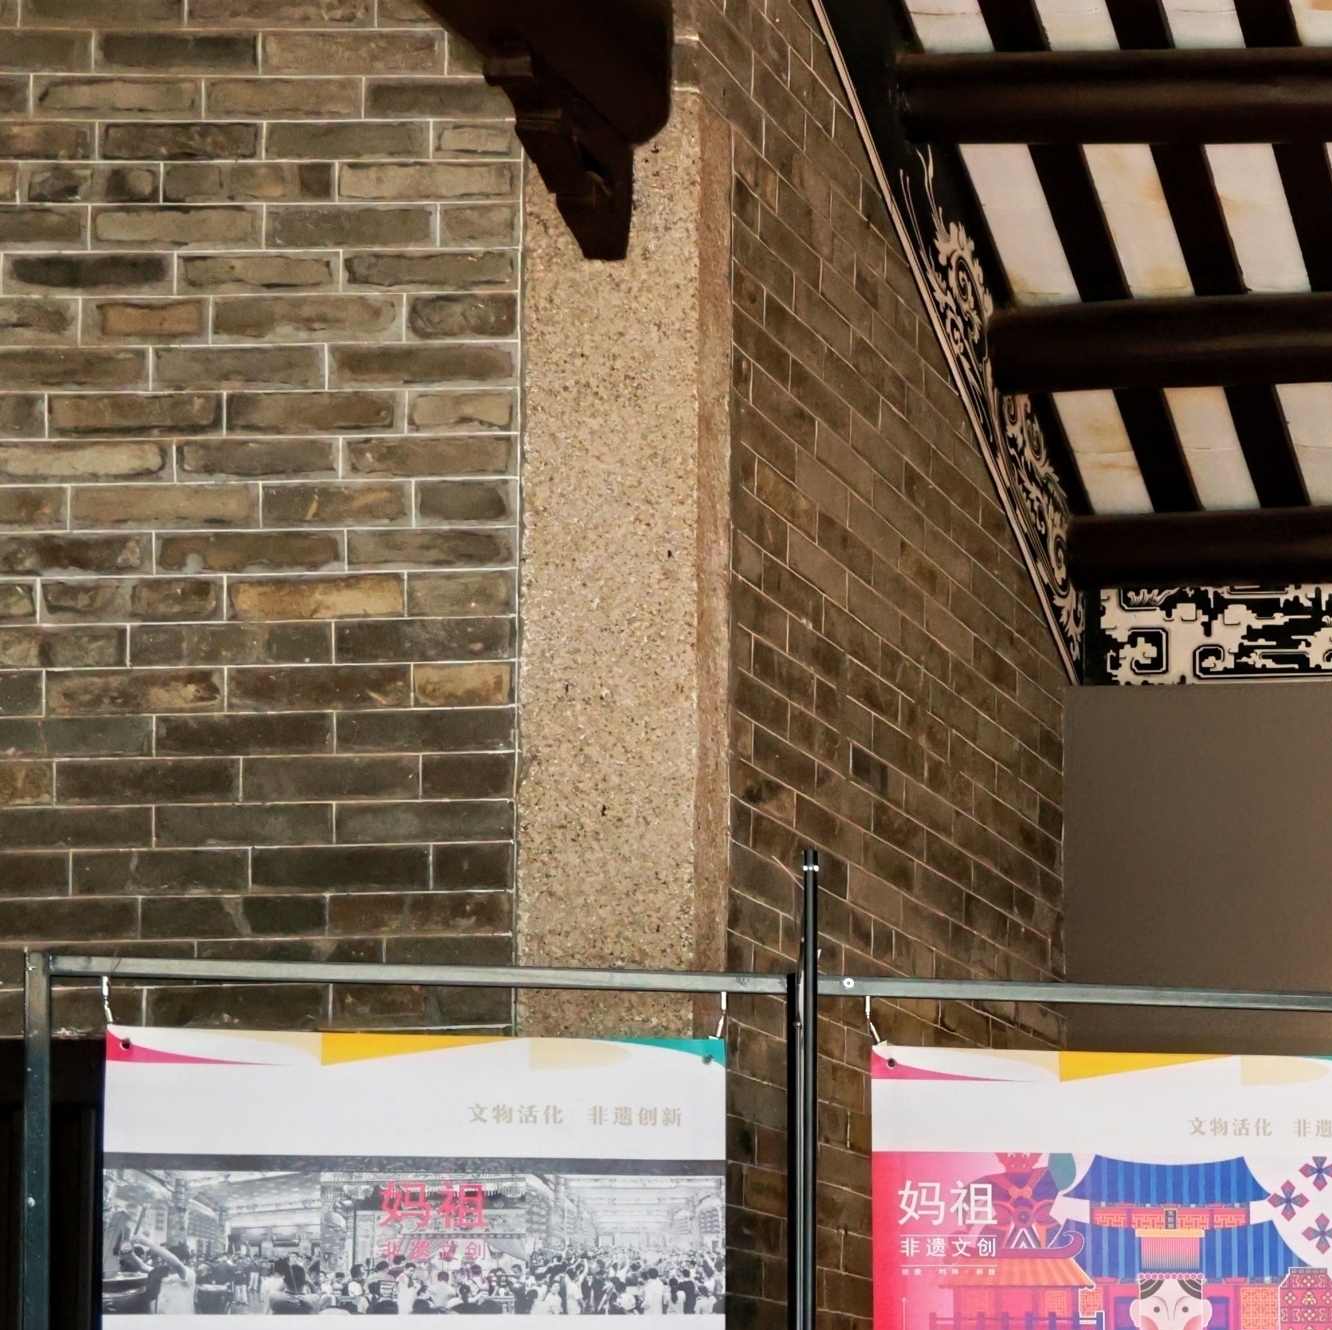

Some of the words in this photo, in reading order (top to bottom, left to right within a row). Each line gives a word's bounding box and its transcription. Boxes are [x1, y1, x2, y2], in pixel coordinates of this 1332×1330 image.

[468, 1103, 564, 1126] 文物活化
[587, 1104, 684, 1128] 非遗创新
[1188, 1117, 1273, 1137] 文物活化
[379, 1180, 489, 1228] 妈祖
[897, 1179, 998, 1226] 妈祖
[900, 1237, 997, 1257] 非遗文创
